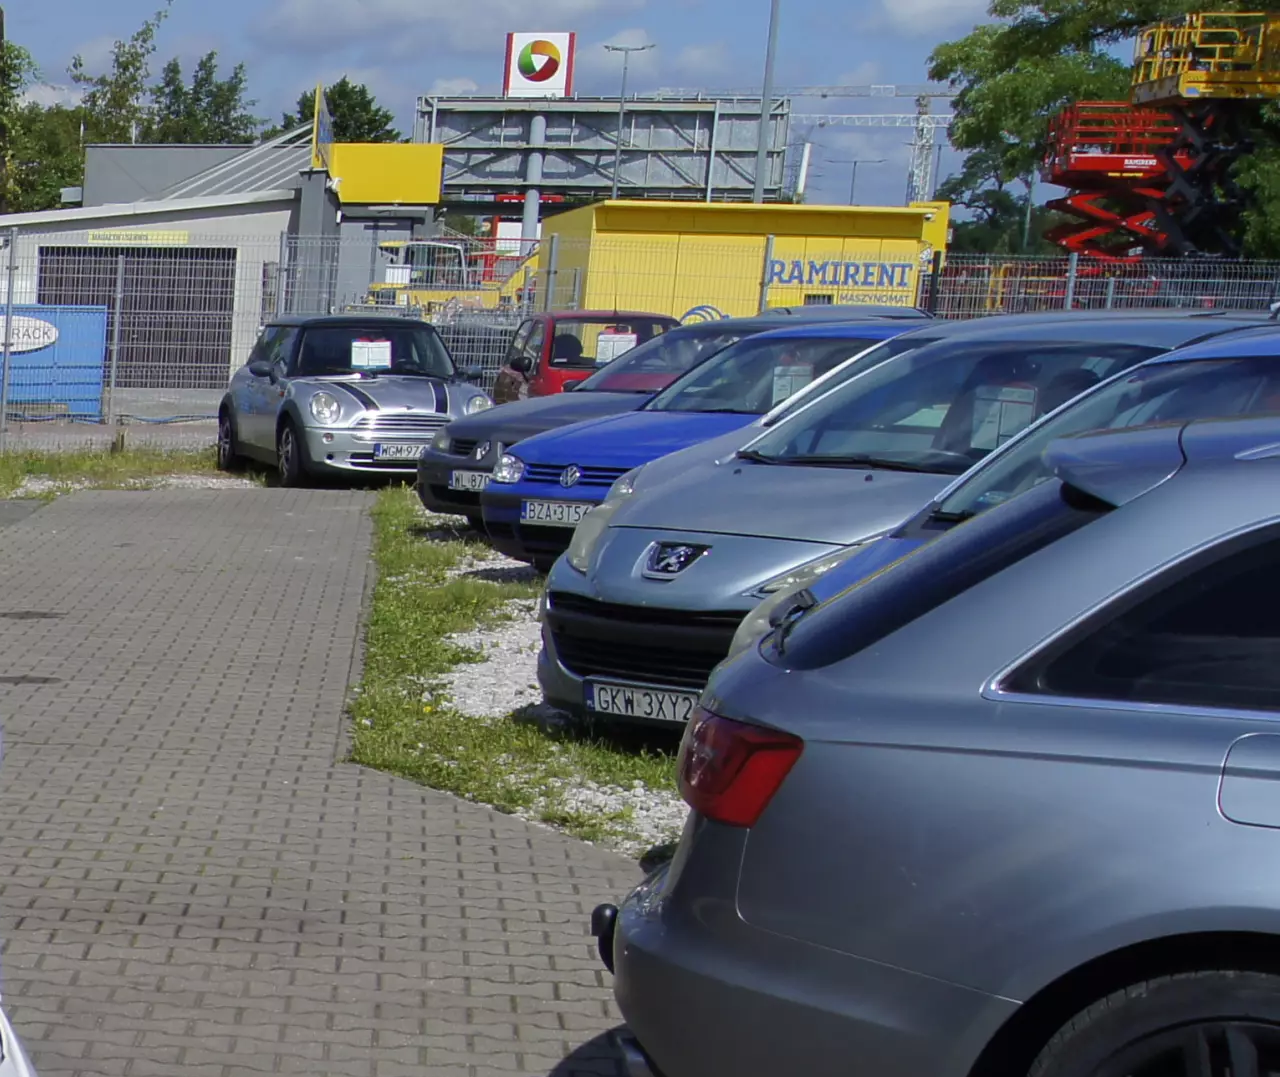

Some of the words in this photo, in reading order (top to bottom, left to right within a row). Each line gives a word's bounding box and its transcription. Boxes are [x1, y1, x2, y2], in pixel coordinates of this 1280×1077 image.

[768, 260, 913, 288] RAMIRENT
[840, 294, 910, 304] MASZYNOMAT
[382, 445, 402, 458] WGM
[454, 472, 466, 488] WL
[529, 502, 552, 520] BZA
[598, 687, 635, 715] GKW
